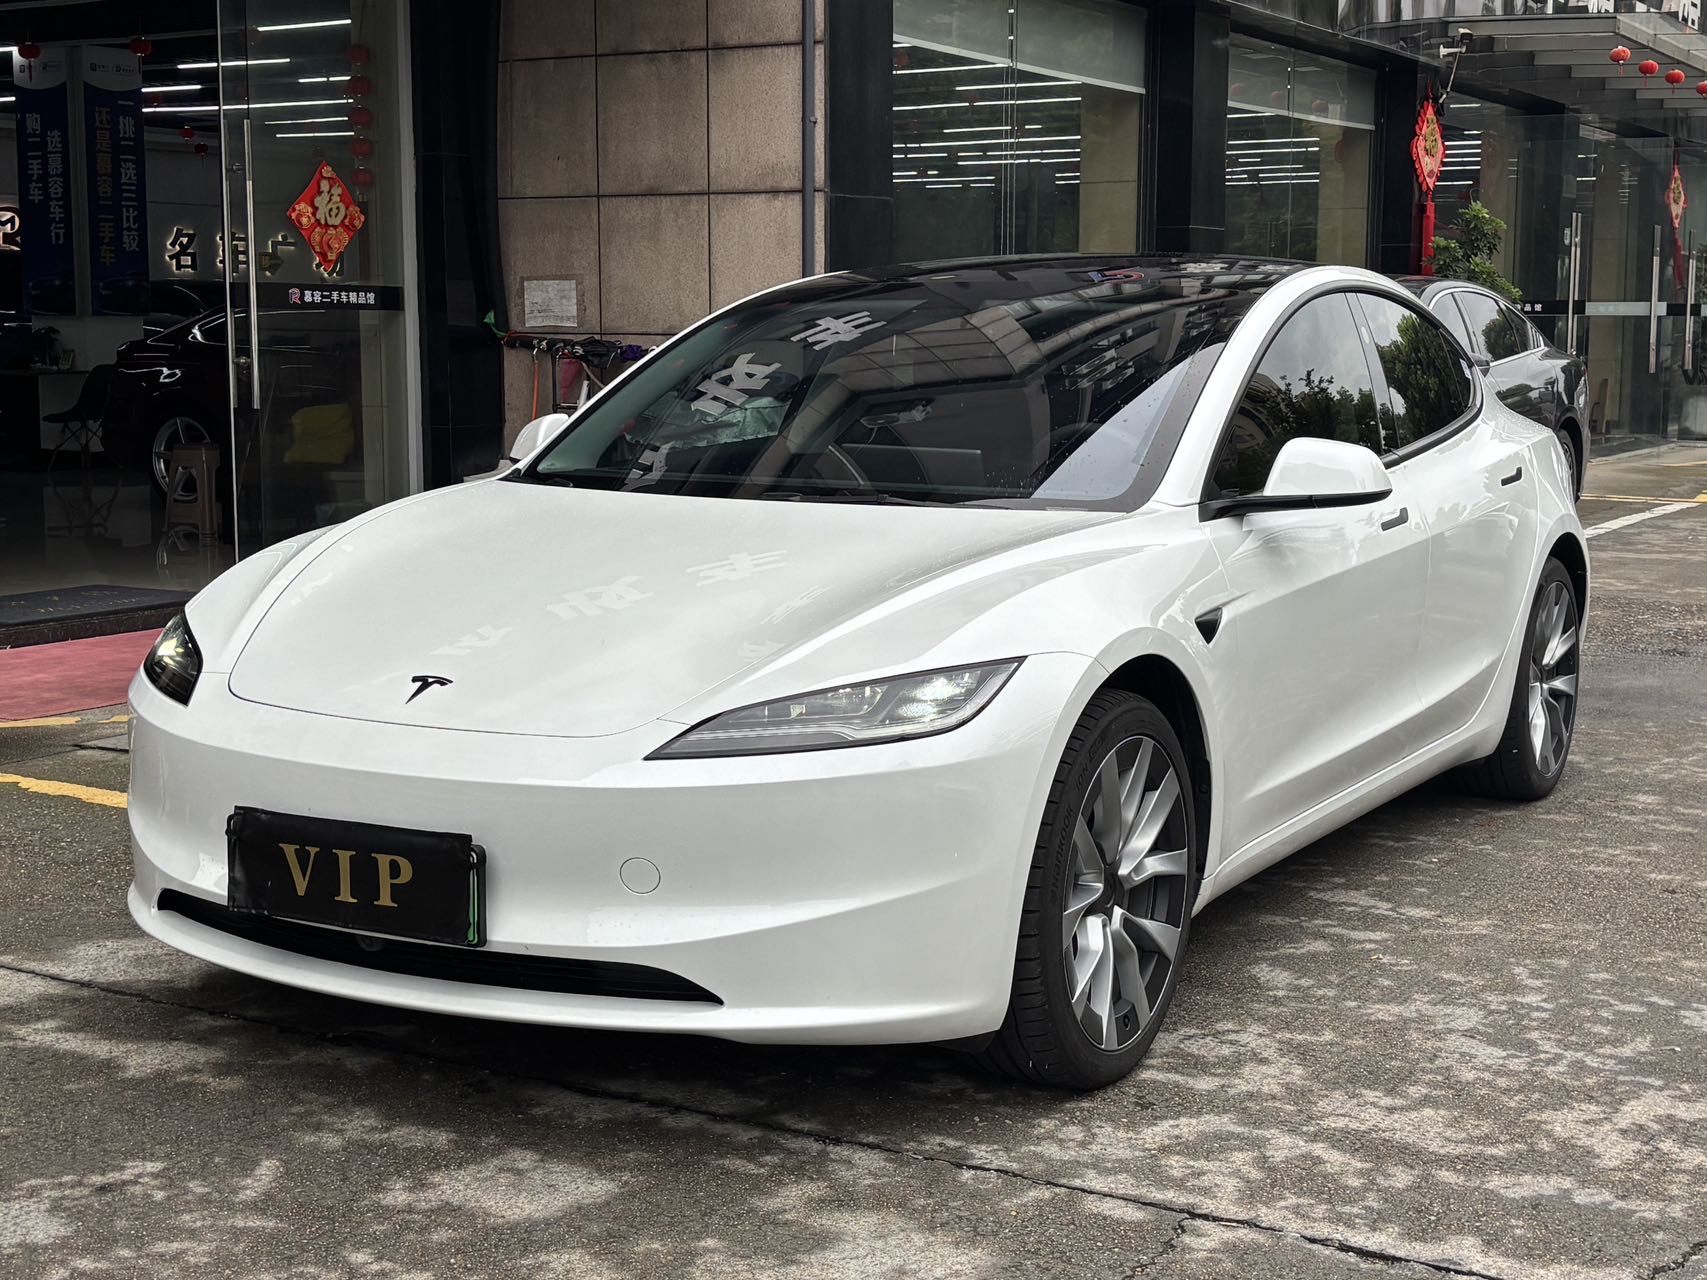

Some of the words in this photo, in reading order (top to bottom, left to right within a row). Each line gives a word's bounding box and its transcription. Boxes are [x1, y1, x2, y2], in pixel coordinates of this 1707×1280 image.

[25, 113, 44, 204] 购二手车
[46, 130, 65, 245] 选慕容车行
[117, 100, 140, 252] 一挑二选三比较
[314, 179, 346, 226] 福
[279, 843, 413, 907] VIP
